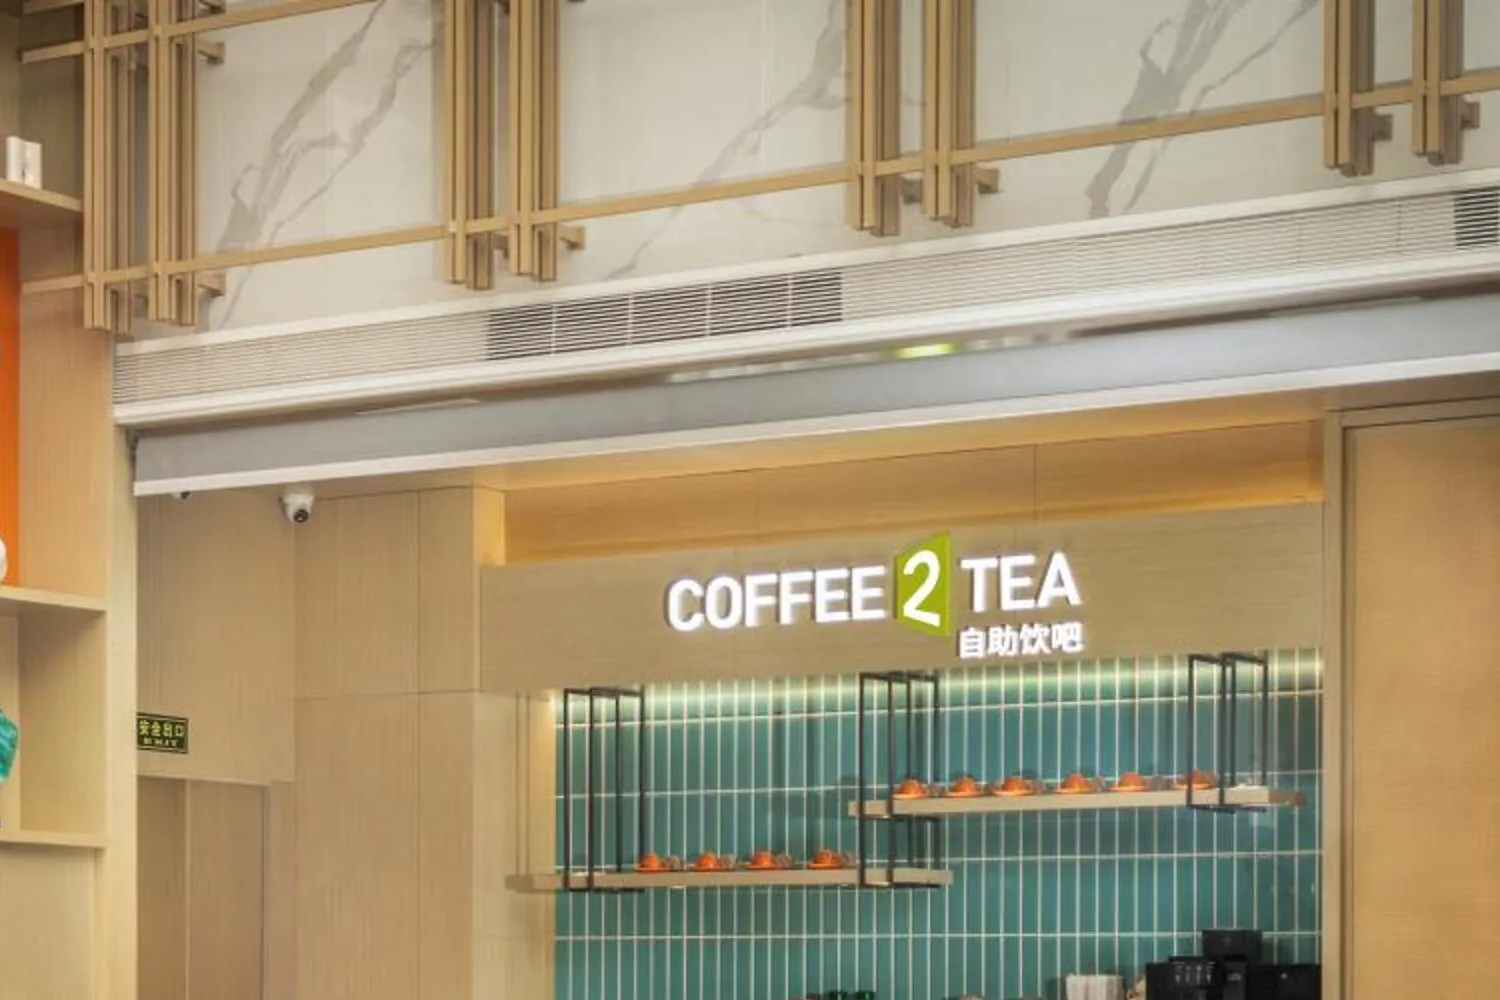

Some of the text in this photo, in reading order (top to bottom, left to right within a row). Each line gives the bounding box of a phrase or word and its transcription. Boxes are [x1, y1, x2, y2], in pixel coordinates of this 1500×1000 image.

[667, 549, 1082, 632] COFFEE 2 TEA
[959, 621, 1084, 660] 自助饮吧
